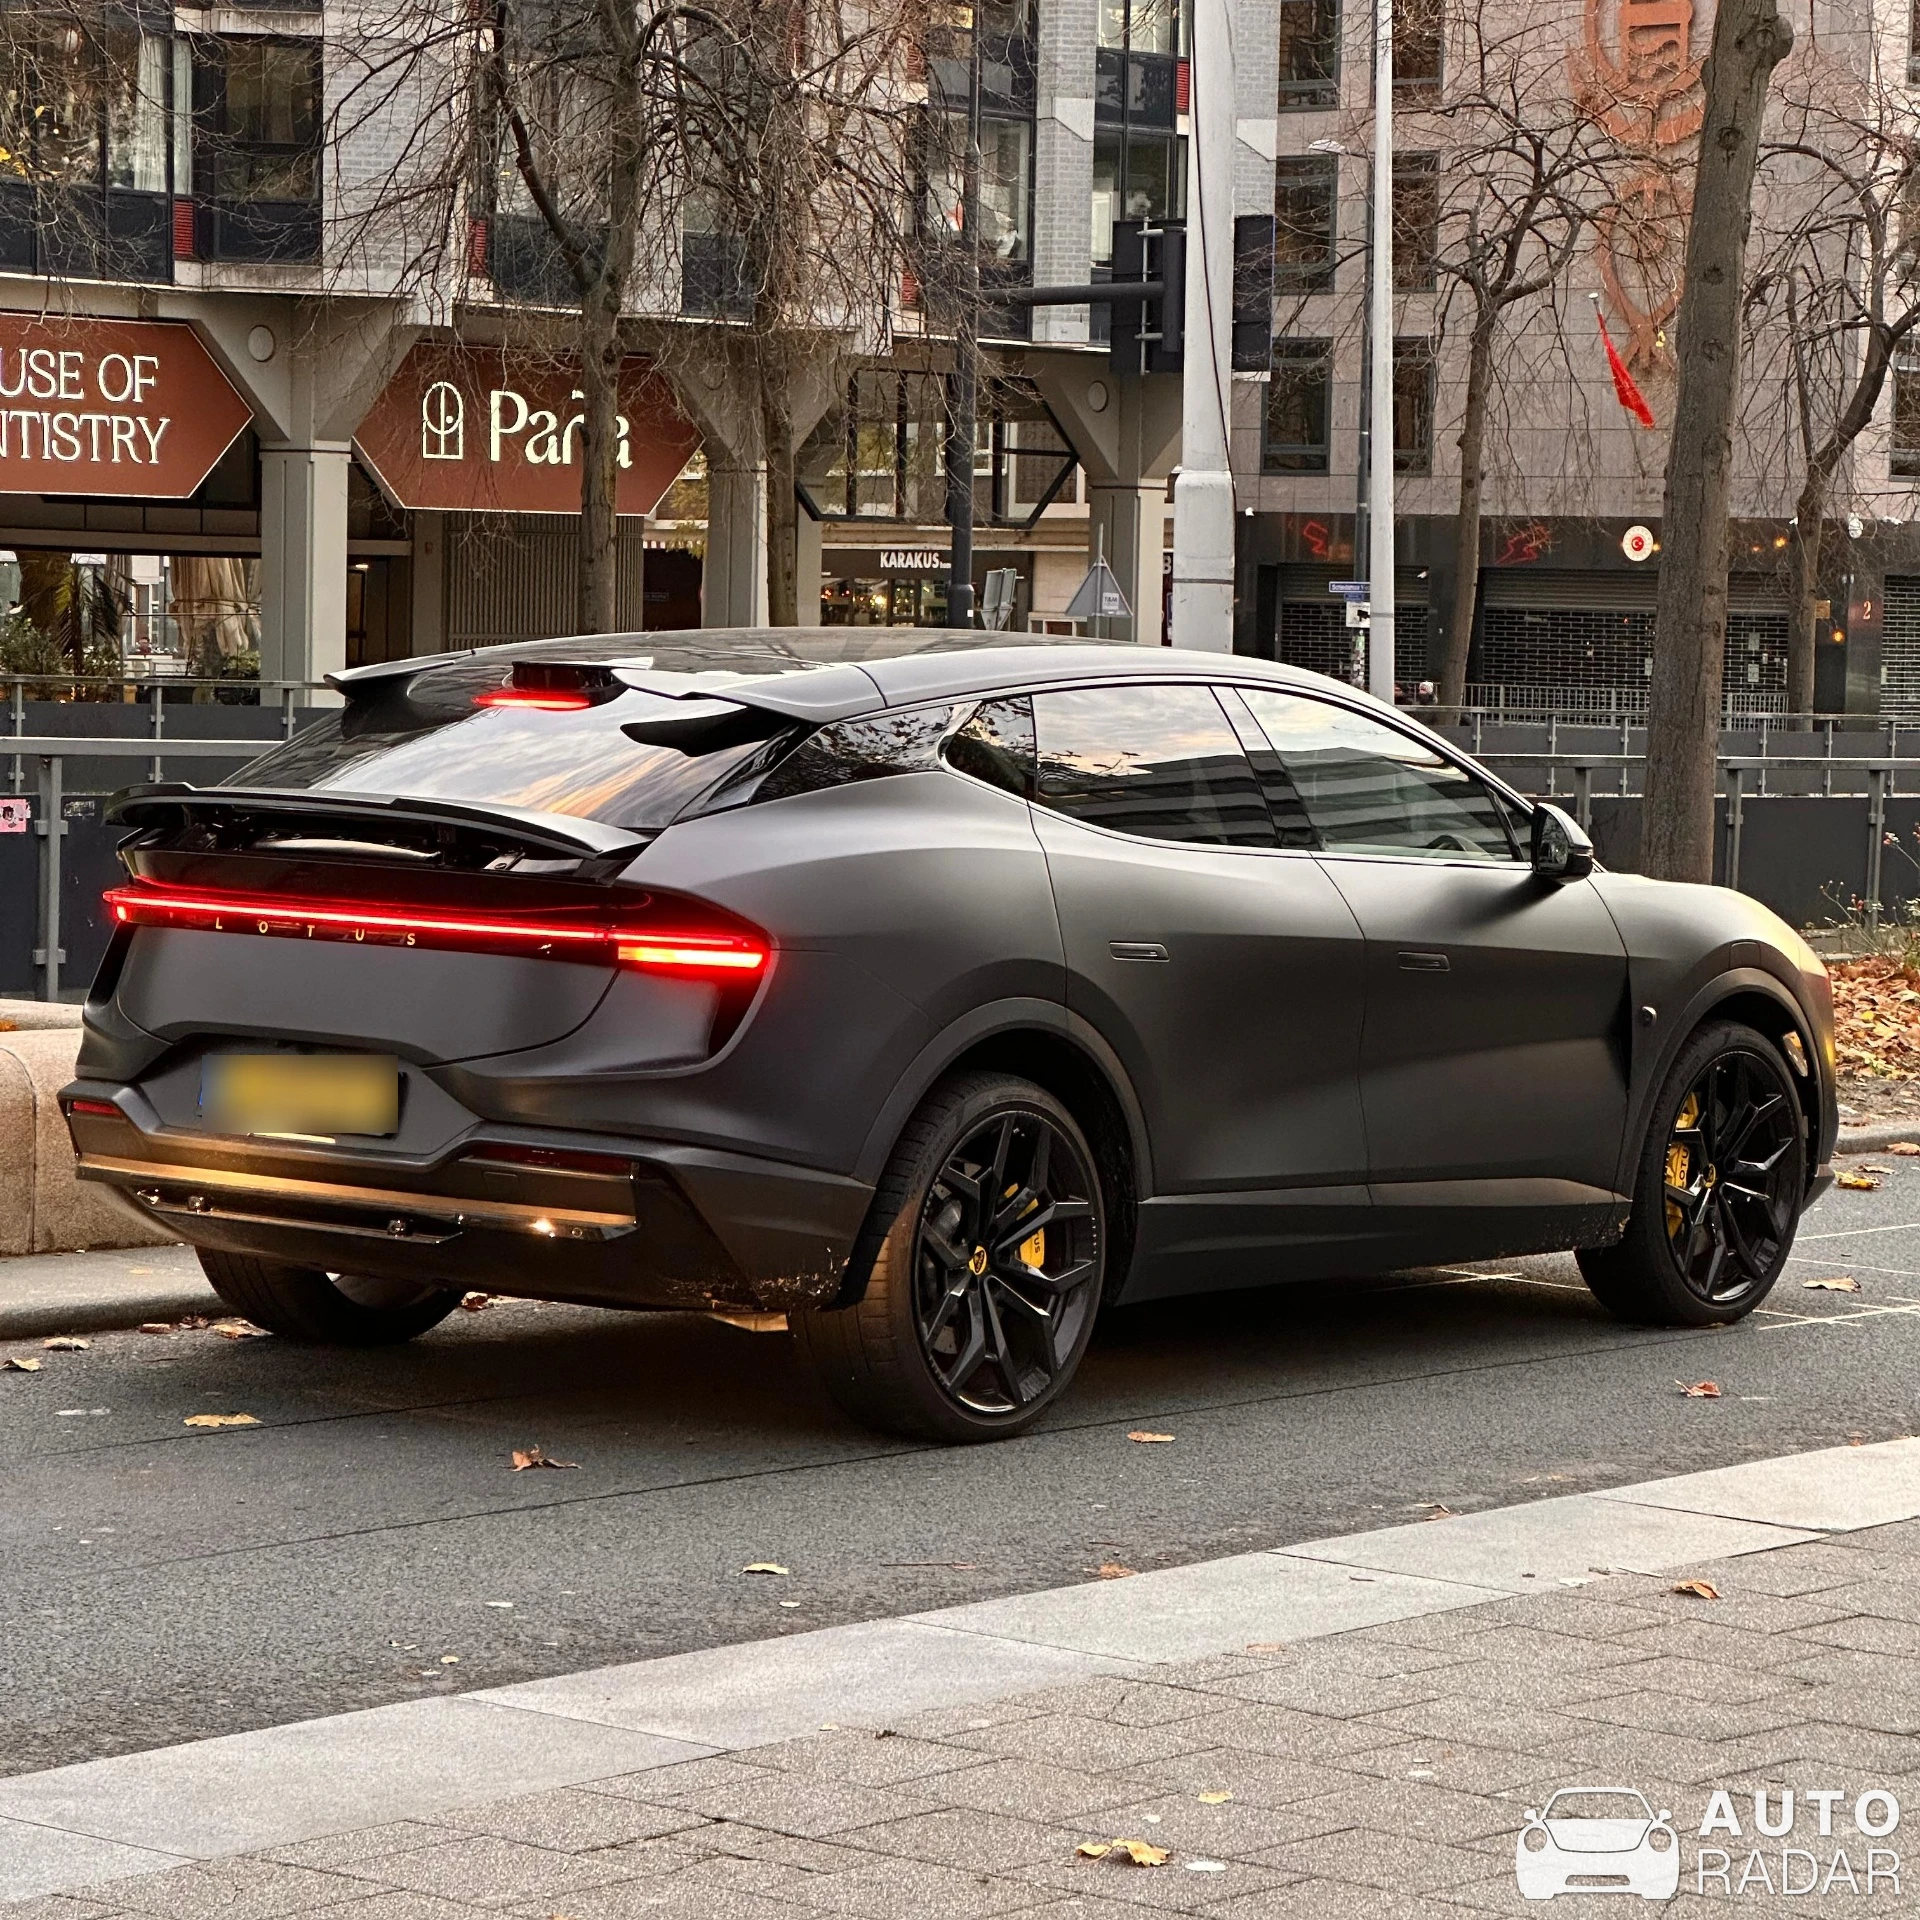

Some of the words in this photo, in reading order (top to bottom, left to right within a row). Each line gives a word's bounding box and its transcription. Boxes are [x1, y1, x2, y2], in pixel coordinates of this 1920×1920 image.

[97, 353, 159, 403] OF
[880, 551, 940, 569] KARAKUS
[1863, 600, 1872, 620] 2
[215, 917, 416, 946] LOTUS
[1679, 1148, 1689, 1188] LOTU
